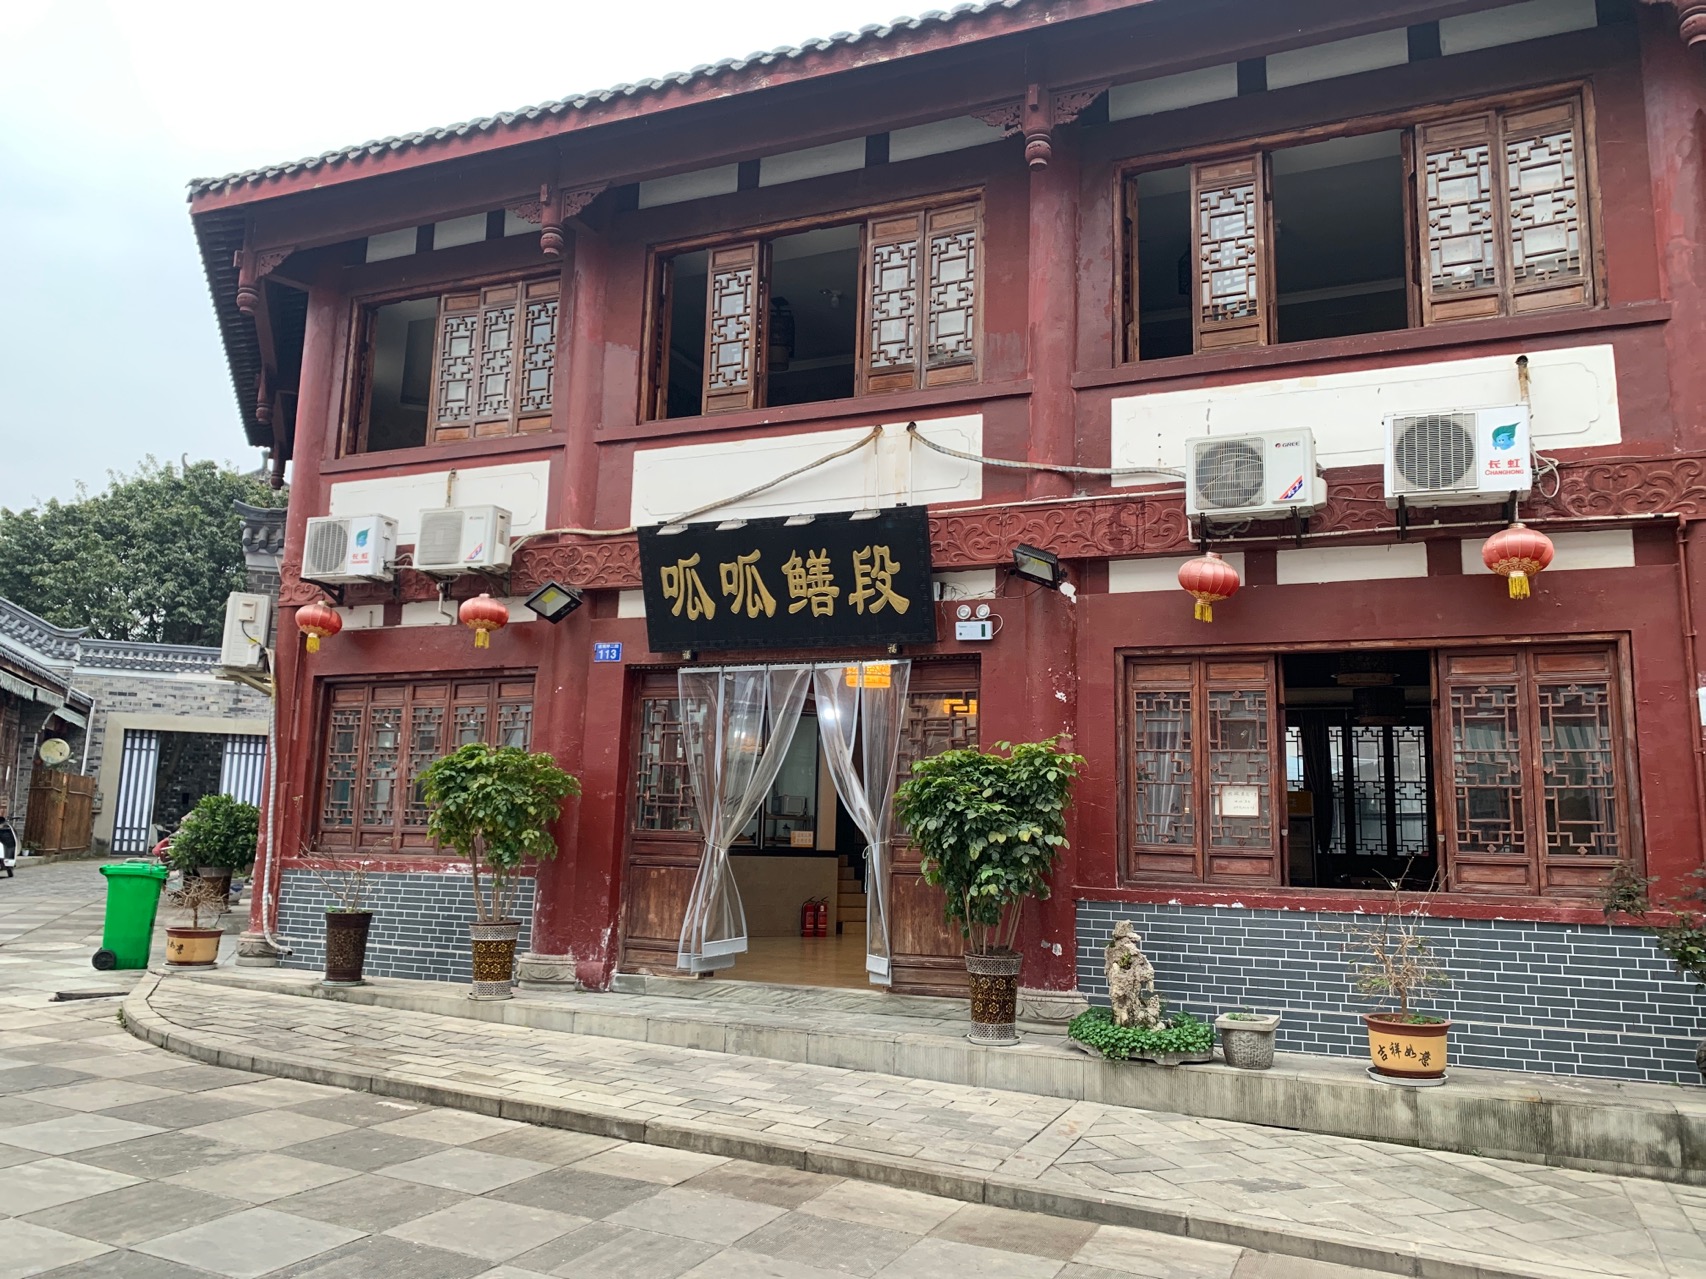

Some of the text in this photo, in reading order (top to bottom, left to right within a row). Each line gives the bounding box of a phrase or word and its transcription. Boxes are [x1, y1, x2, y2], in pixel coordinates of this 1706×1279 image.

[1488, 458, 1521, 469] 长虹
[659, 544, 911, 621] 呱呱鳝段
[598, 649, 617, 660] 113
